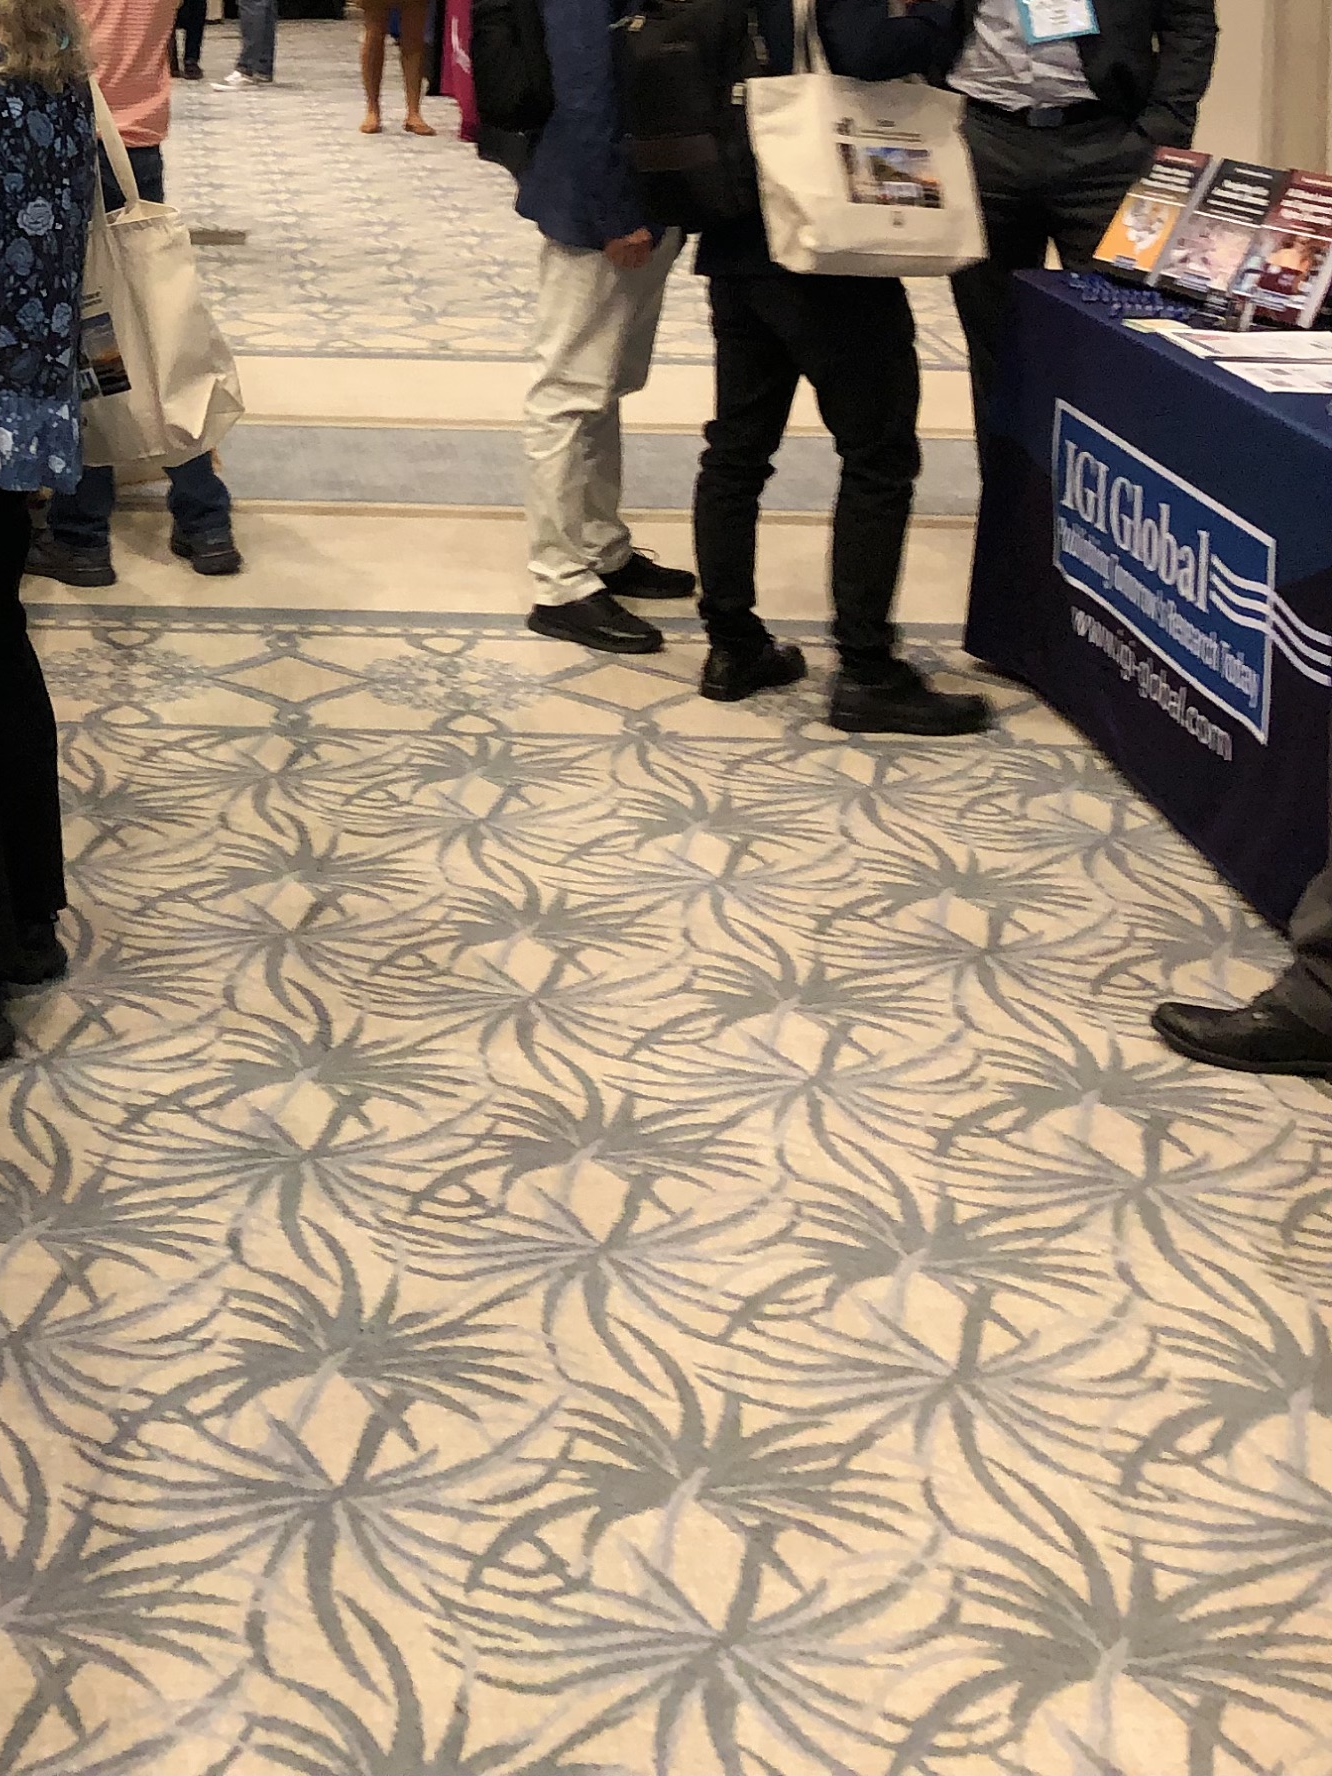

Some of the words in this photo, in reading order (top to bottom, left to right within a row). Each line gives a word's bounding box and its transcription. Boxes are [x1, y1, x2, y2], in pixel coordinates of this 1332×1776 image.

[1061, 440, 1109, 533] IGI
[1110, 476, 1210, 613] Global
[1220, 641, 1260, 707] Today
